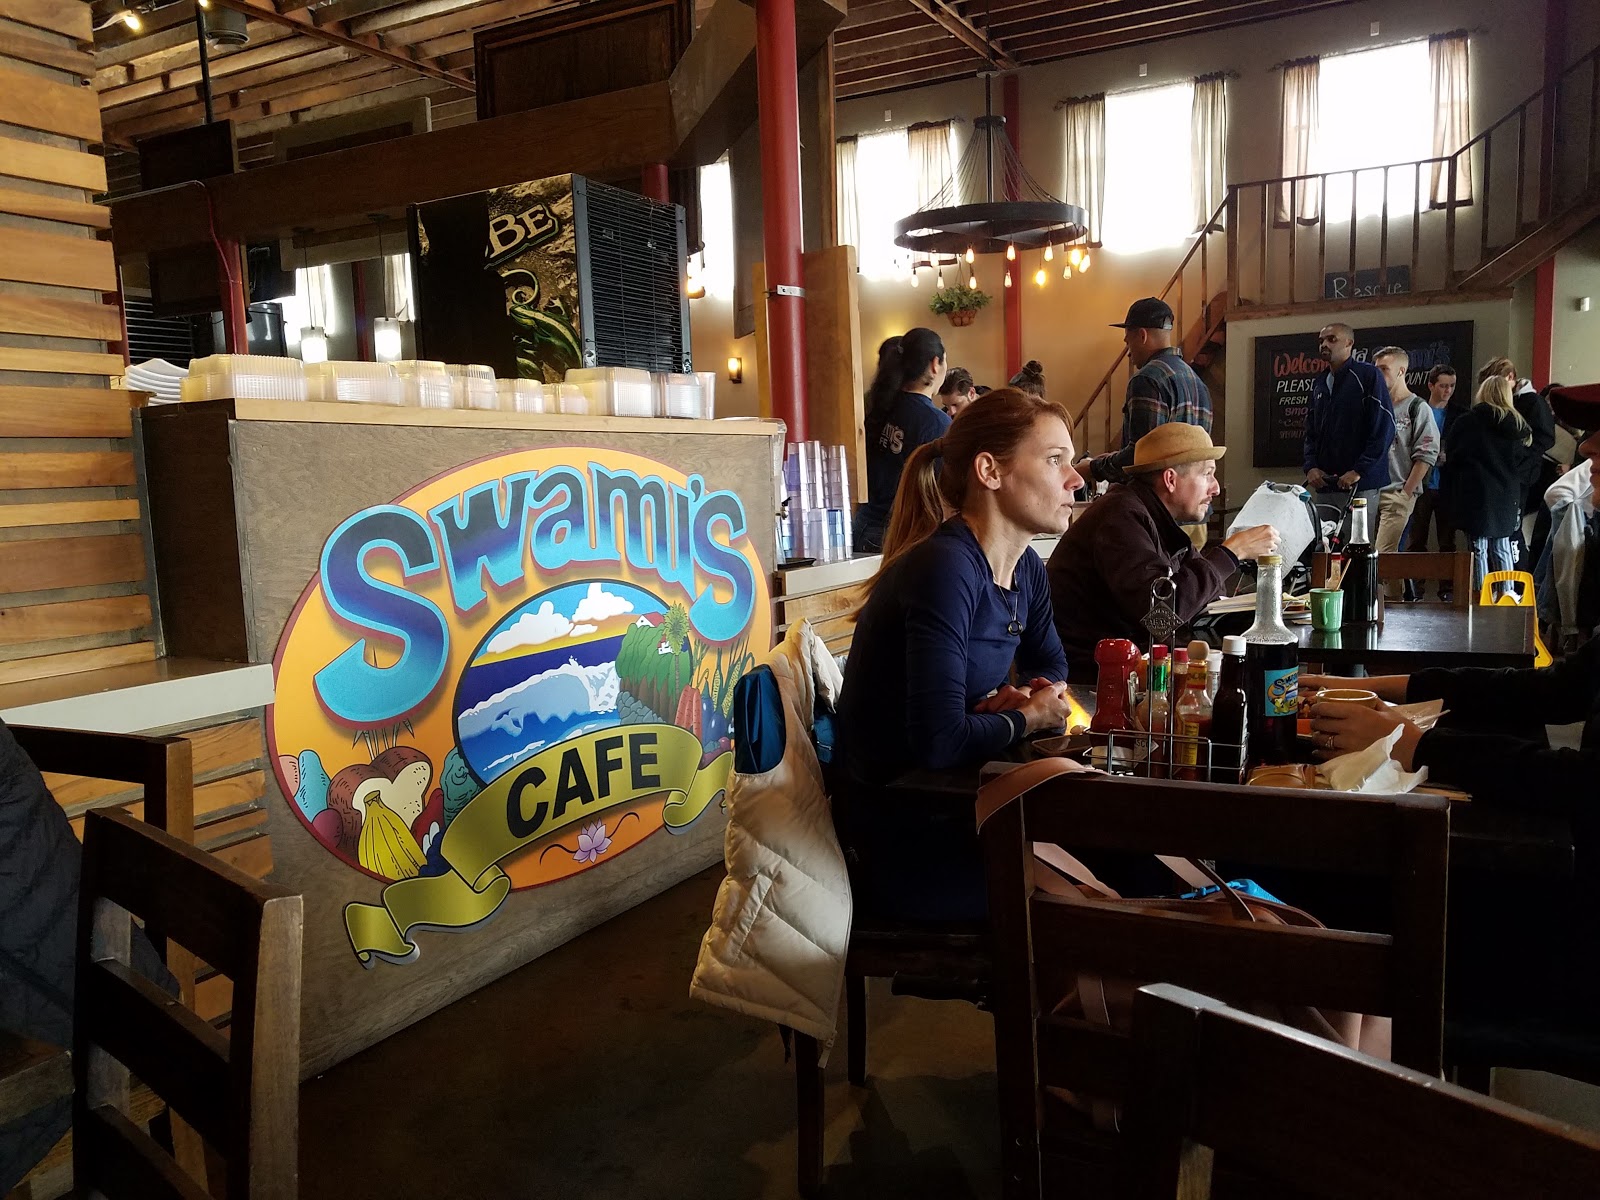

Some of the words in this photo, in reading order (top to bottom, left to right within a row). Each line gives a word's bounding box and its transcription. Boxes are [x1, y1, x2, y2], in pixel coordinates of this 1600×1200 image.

[488, 203, 555, 259] BE
[1273, 352, 1330, 377] Welcom
[1405, 371, 1430, 386] OUNT
[1279, 395, 1309, 405] FRESH
[313, 461, 756, 731] Swami's
[505, 731, 661, 839] CAFE
